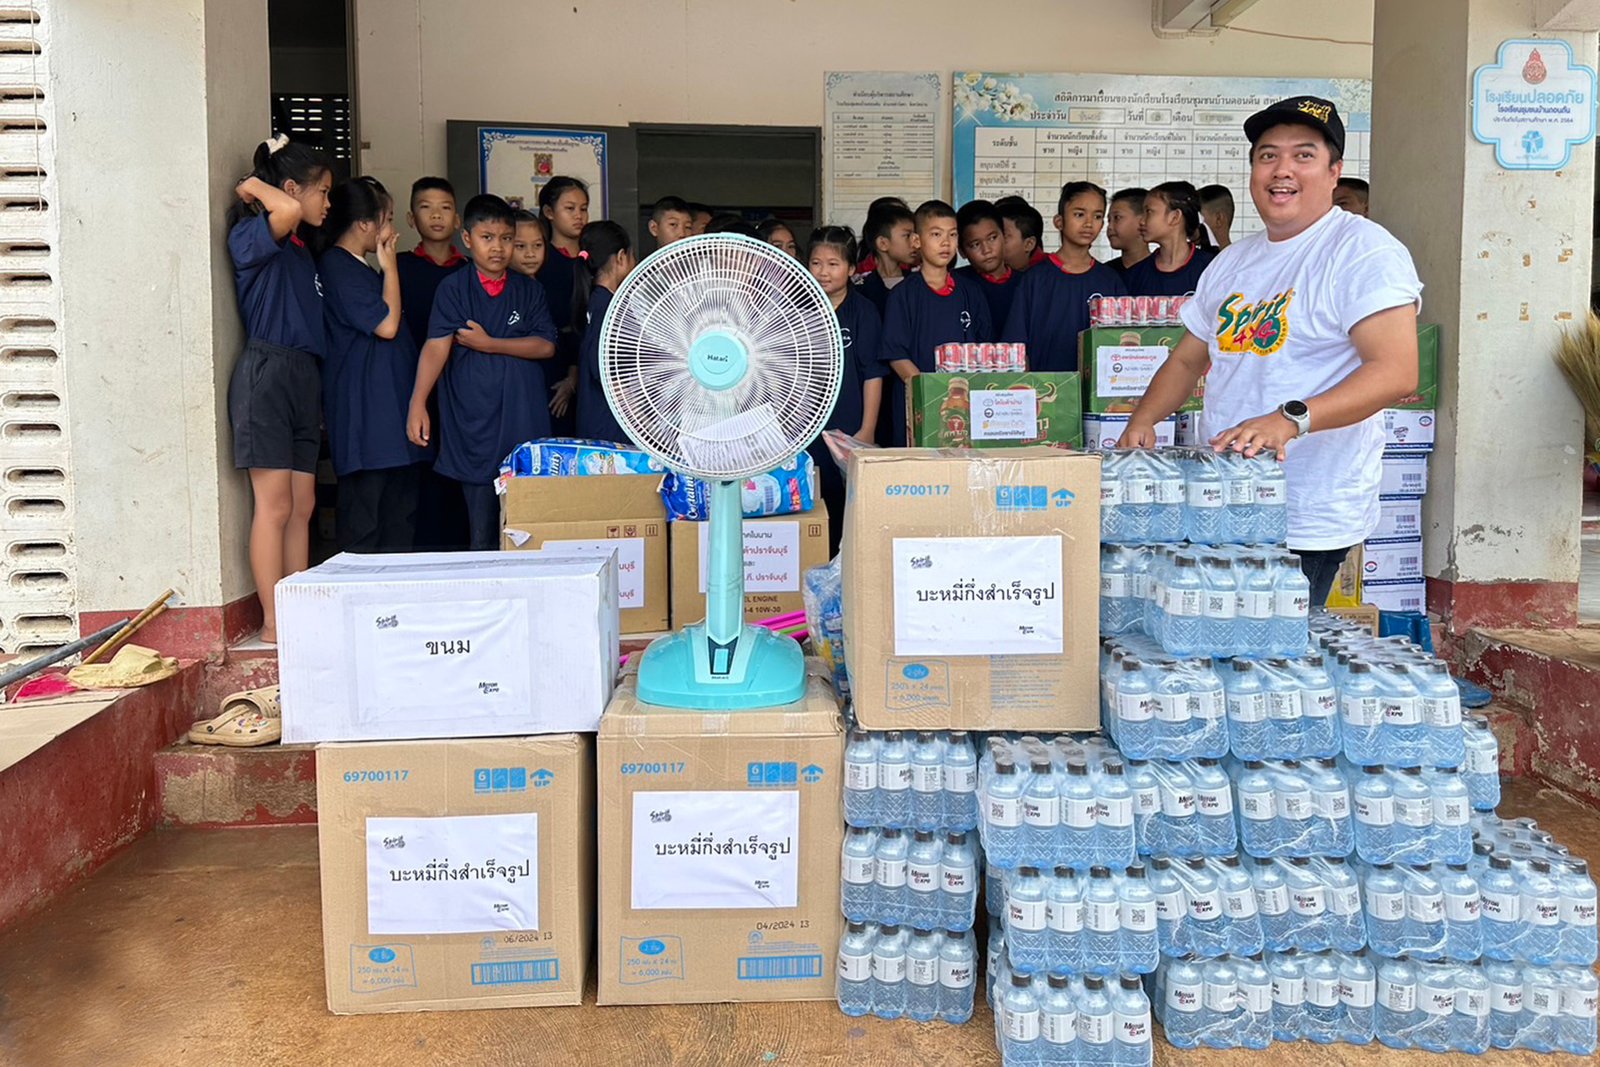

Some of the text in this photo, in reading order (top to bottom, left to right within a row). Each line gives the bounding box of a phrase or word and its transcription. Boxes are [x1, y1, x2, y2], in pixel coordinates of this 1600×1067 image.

[1485, 89, 1584, 104] โรงเรียนปลอดภัย
[885, 484, 950, 497] 69700117
[916, 578, 1055, 606] บะหมี่กึ่งสำเร็จรูป
[425, 640, 470, 655] ขนม
[620, 762, 685, 774] 69700117
[343, 770, 409, 783] 69700117
[654, 832, 791, 860] บะหมี่กึ่งสำเร็จรูป
[390, 859, 530, 883] บะหมี่กึ่งสำเร็จรูป
[756, 920, 810, 930] 04/2024 13
[504, 931, 553, 944] 06/2024 13
